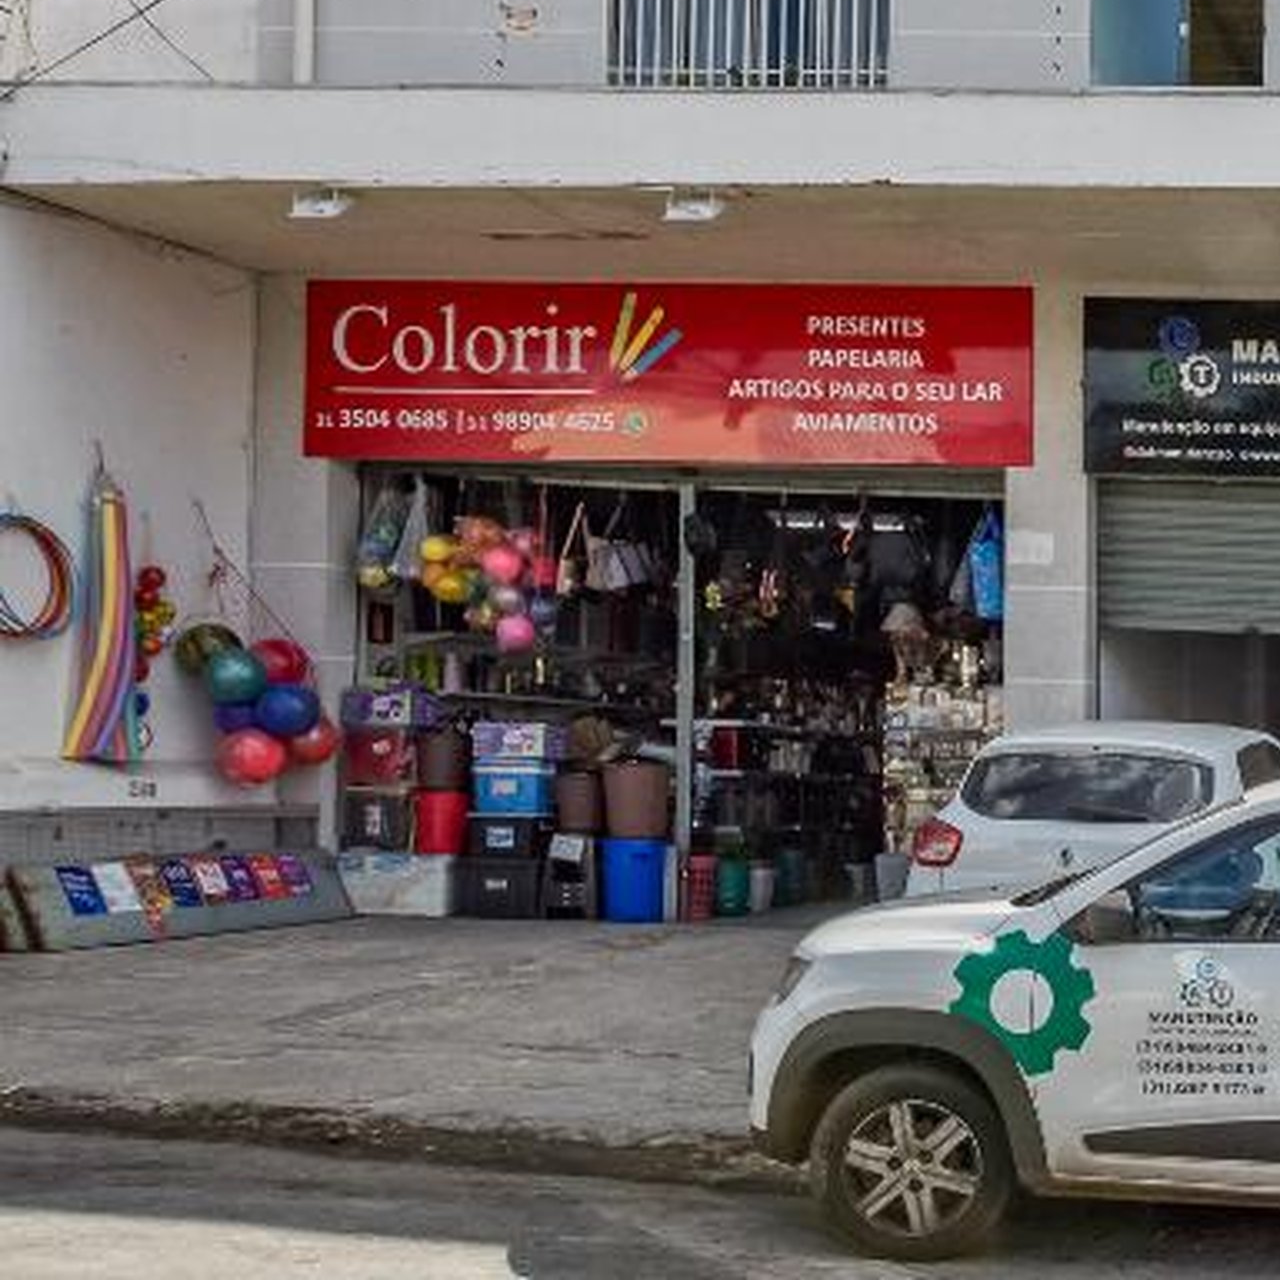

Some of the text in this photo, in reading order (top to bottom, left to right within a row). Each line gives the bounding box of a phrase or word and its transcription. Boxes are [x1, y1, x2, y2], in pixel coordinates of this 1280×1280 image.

[806, 315, 926, 338] PRESENTES
[333, 304, 598, 375] Colorir
[807, 348, 925, 369] PAPELARIA
[728, 379, 1003, 402] ARTIGOS PARA O SEU LAR
[792, 412, 939, 435] AVIAMENTOS
